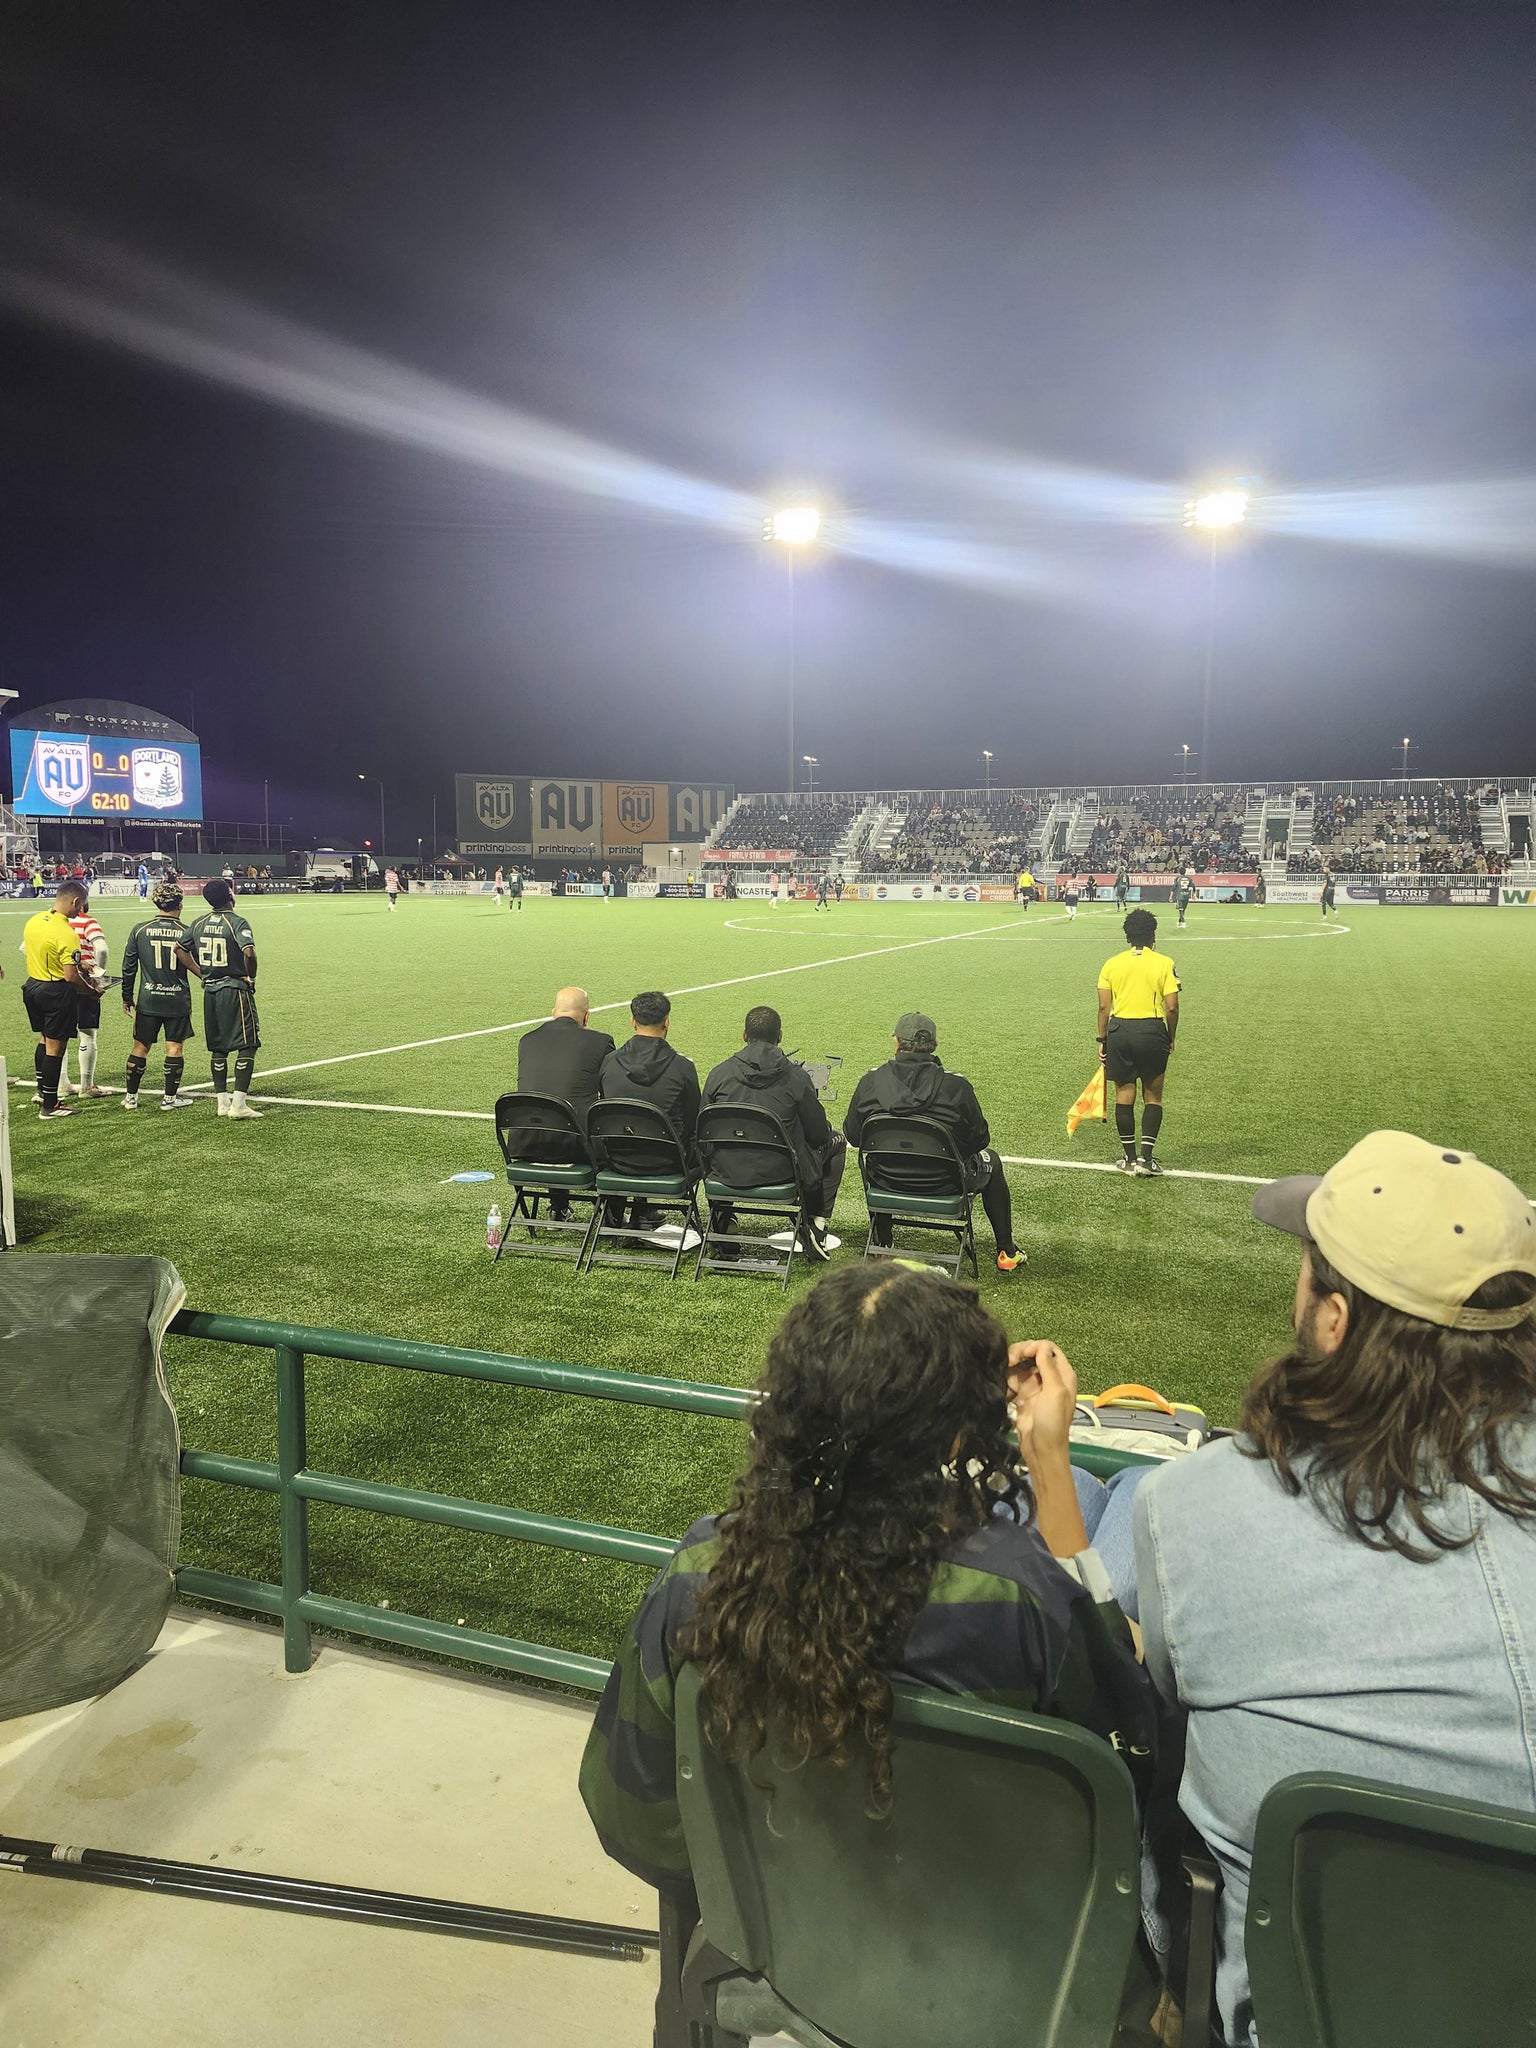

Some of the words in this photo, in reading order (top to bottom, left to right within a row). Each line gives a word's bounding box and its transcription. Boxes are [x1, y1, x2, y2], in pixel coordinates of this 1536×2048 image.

[84, 714, 169, 728] GONZALEZ
[43, 747, 56, 755] AV
[58, 748, 83, 756] ALTA
[135, 750, 179, 765] PORTLAND
[93, 752, 103, 769] 0
[119, 755, 129, 771] 0
[44, 756, 84, 790] AU
[92, 793, 130, 811] 62:10
[480, 791, 511, 819] AU
[541, 783, 594, 832] AU
[622, 796, 650, 823] AU
[466, 844, 526, 855] printingboss
[538, 844, 596, 856] printingboss
[1129, 875, 1155, 886] FAMILY
[737, 887, 770, 895] NCASTE
[1272, 890, 1308, 898] Southwest
[1386, 889, 1430, 897] PARRIS
[146, 928, 183, 938] MARIONA
[198, 936, 228, 967] 20
